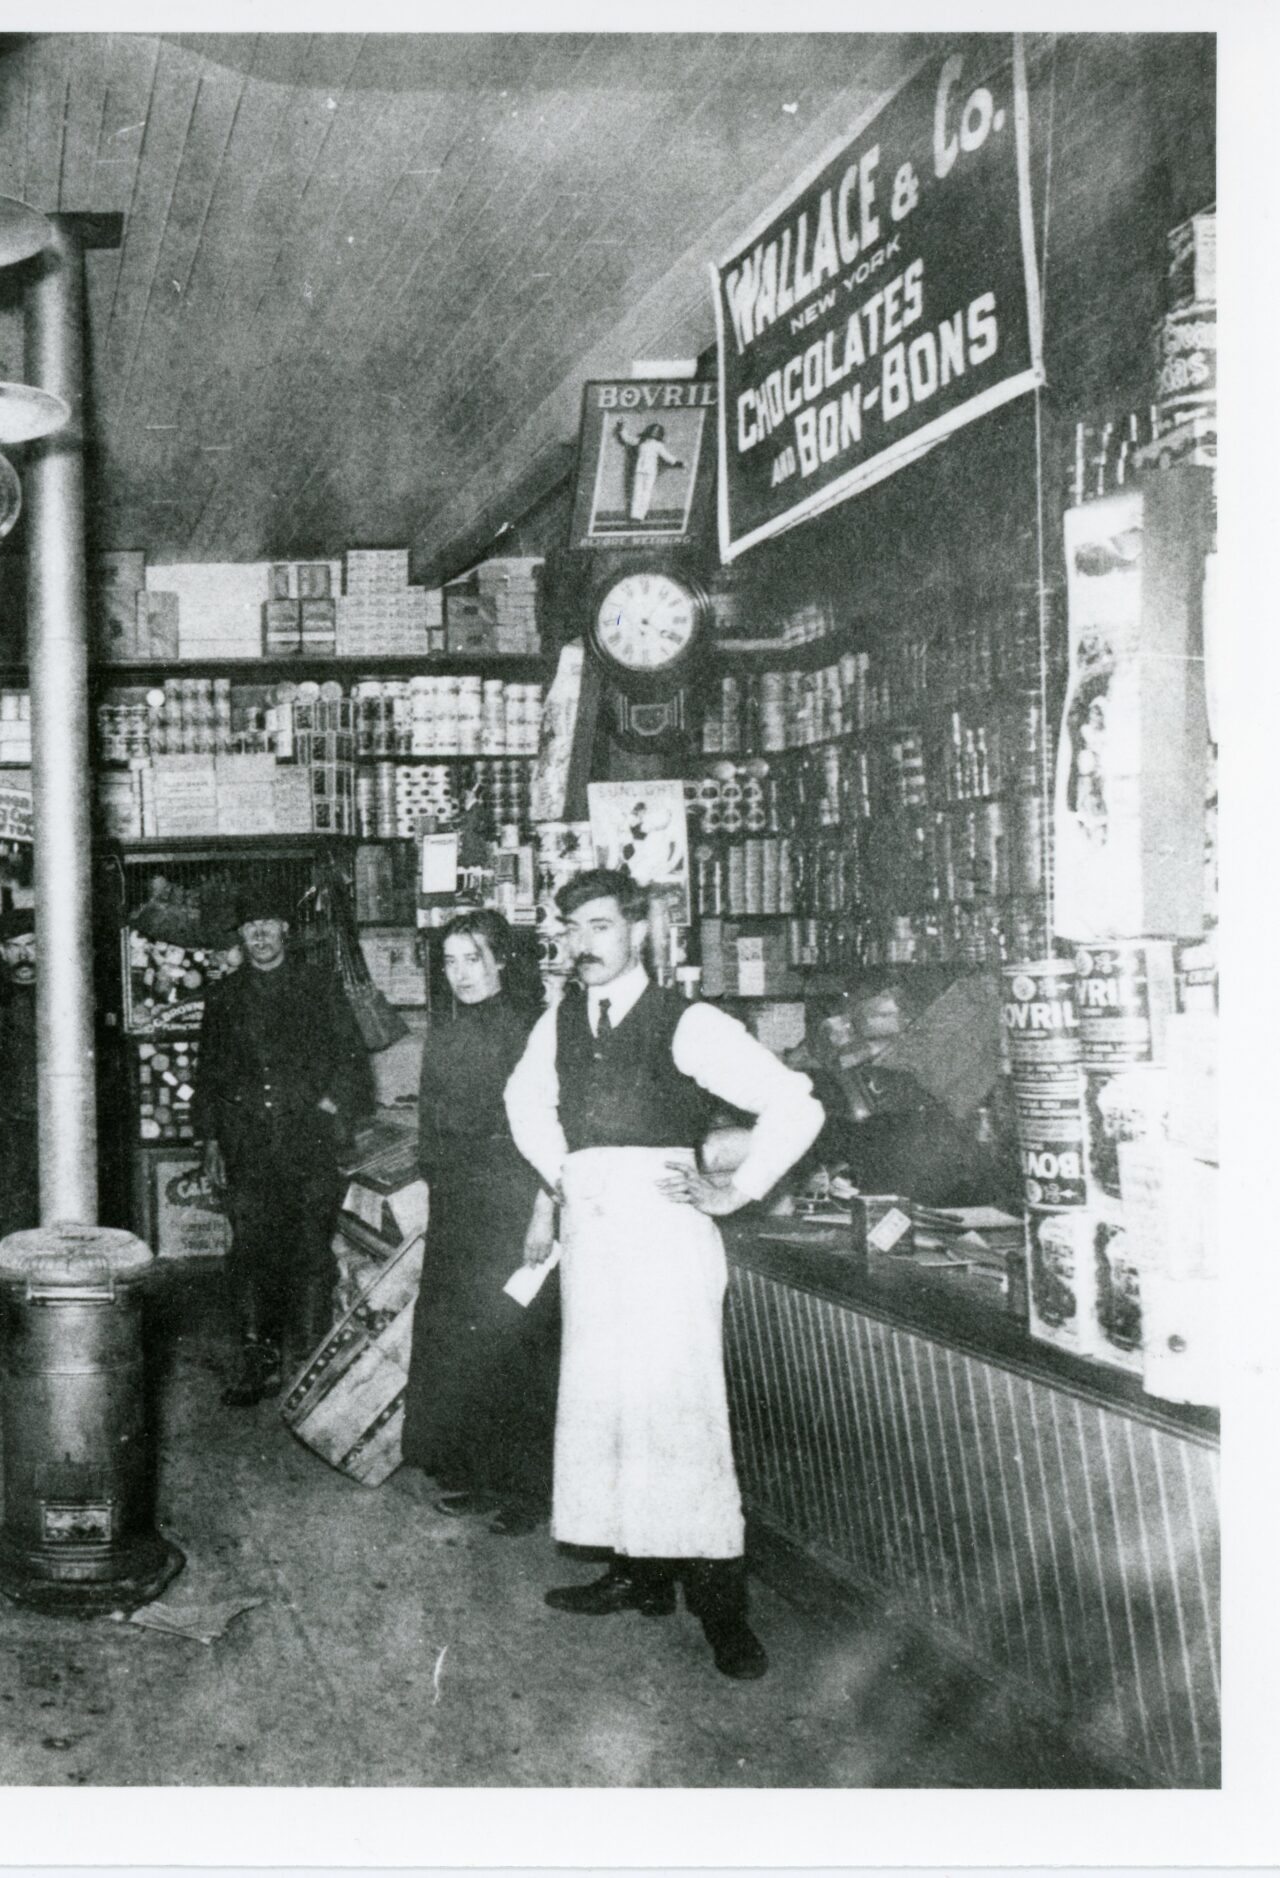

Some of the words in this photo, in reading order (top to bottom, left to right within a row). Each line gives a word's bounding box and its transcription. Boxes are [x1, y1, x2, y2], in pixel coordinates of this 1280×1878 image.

[726, 144, 880, 355] WALLACE
[890, 161, 919, 222] &
[933, 54, 1006, 179] Co.
[737, 258, 923, 453] CHOCOLATES
[790, 289, 837, 335] NEW
[842, 233, 901, 292] YORK
[597, 385, 717, 409] BOVRIL
[770, 447, 796, 488] AND
[795, 291, 998, 479] BON-BONS
[1004, 1001, 1081, 1028] OVRIL
